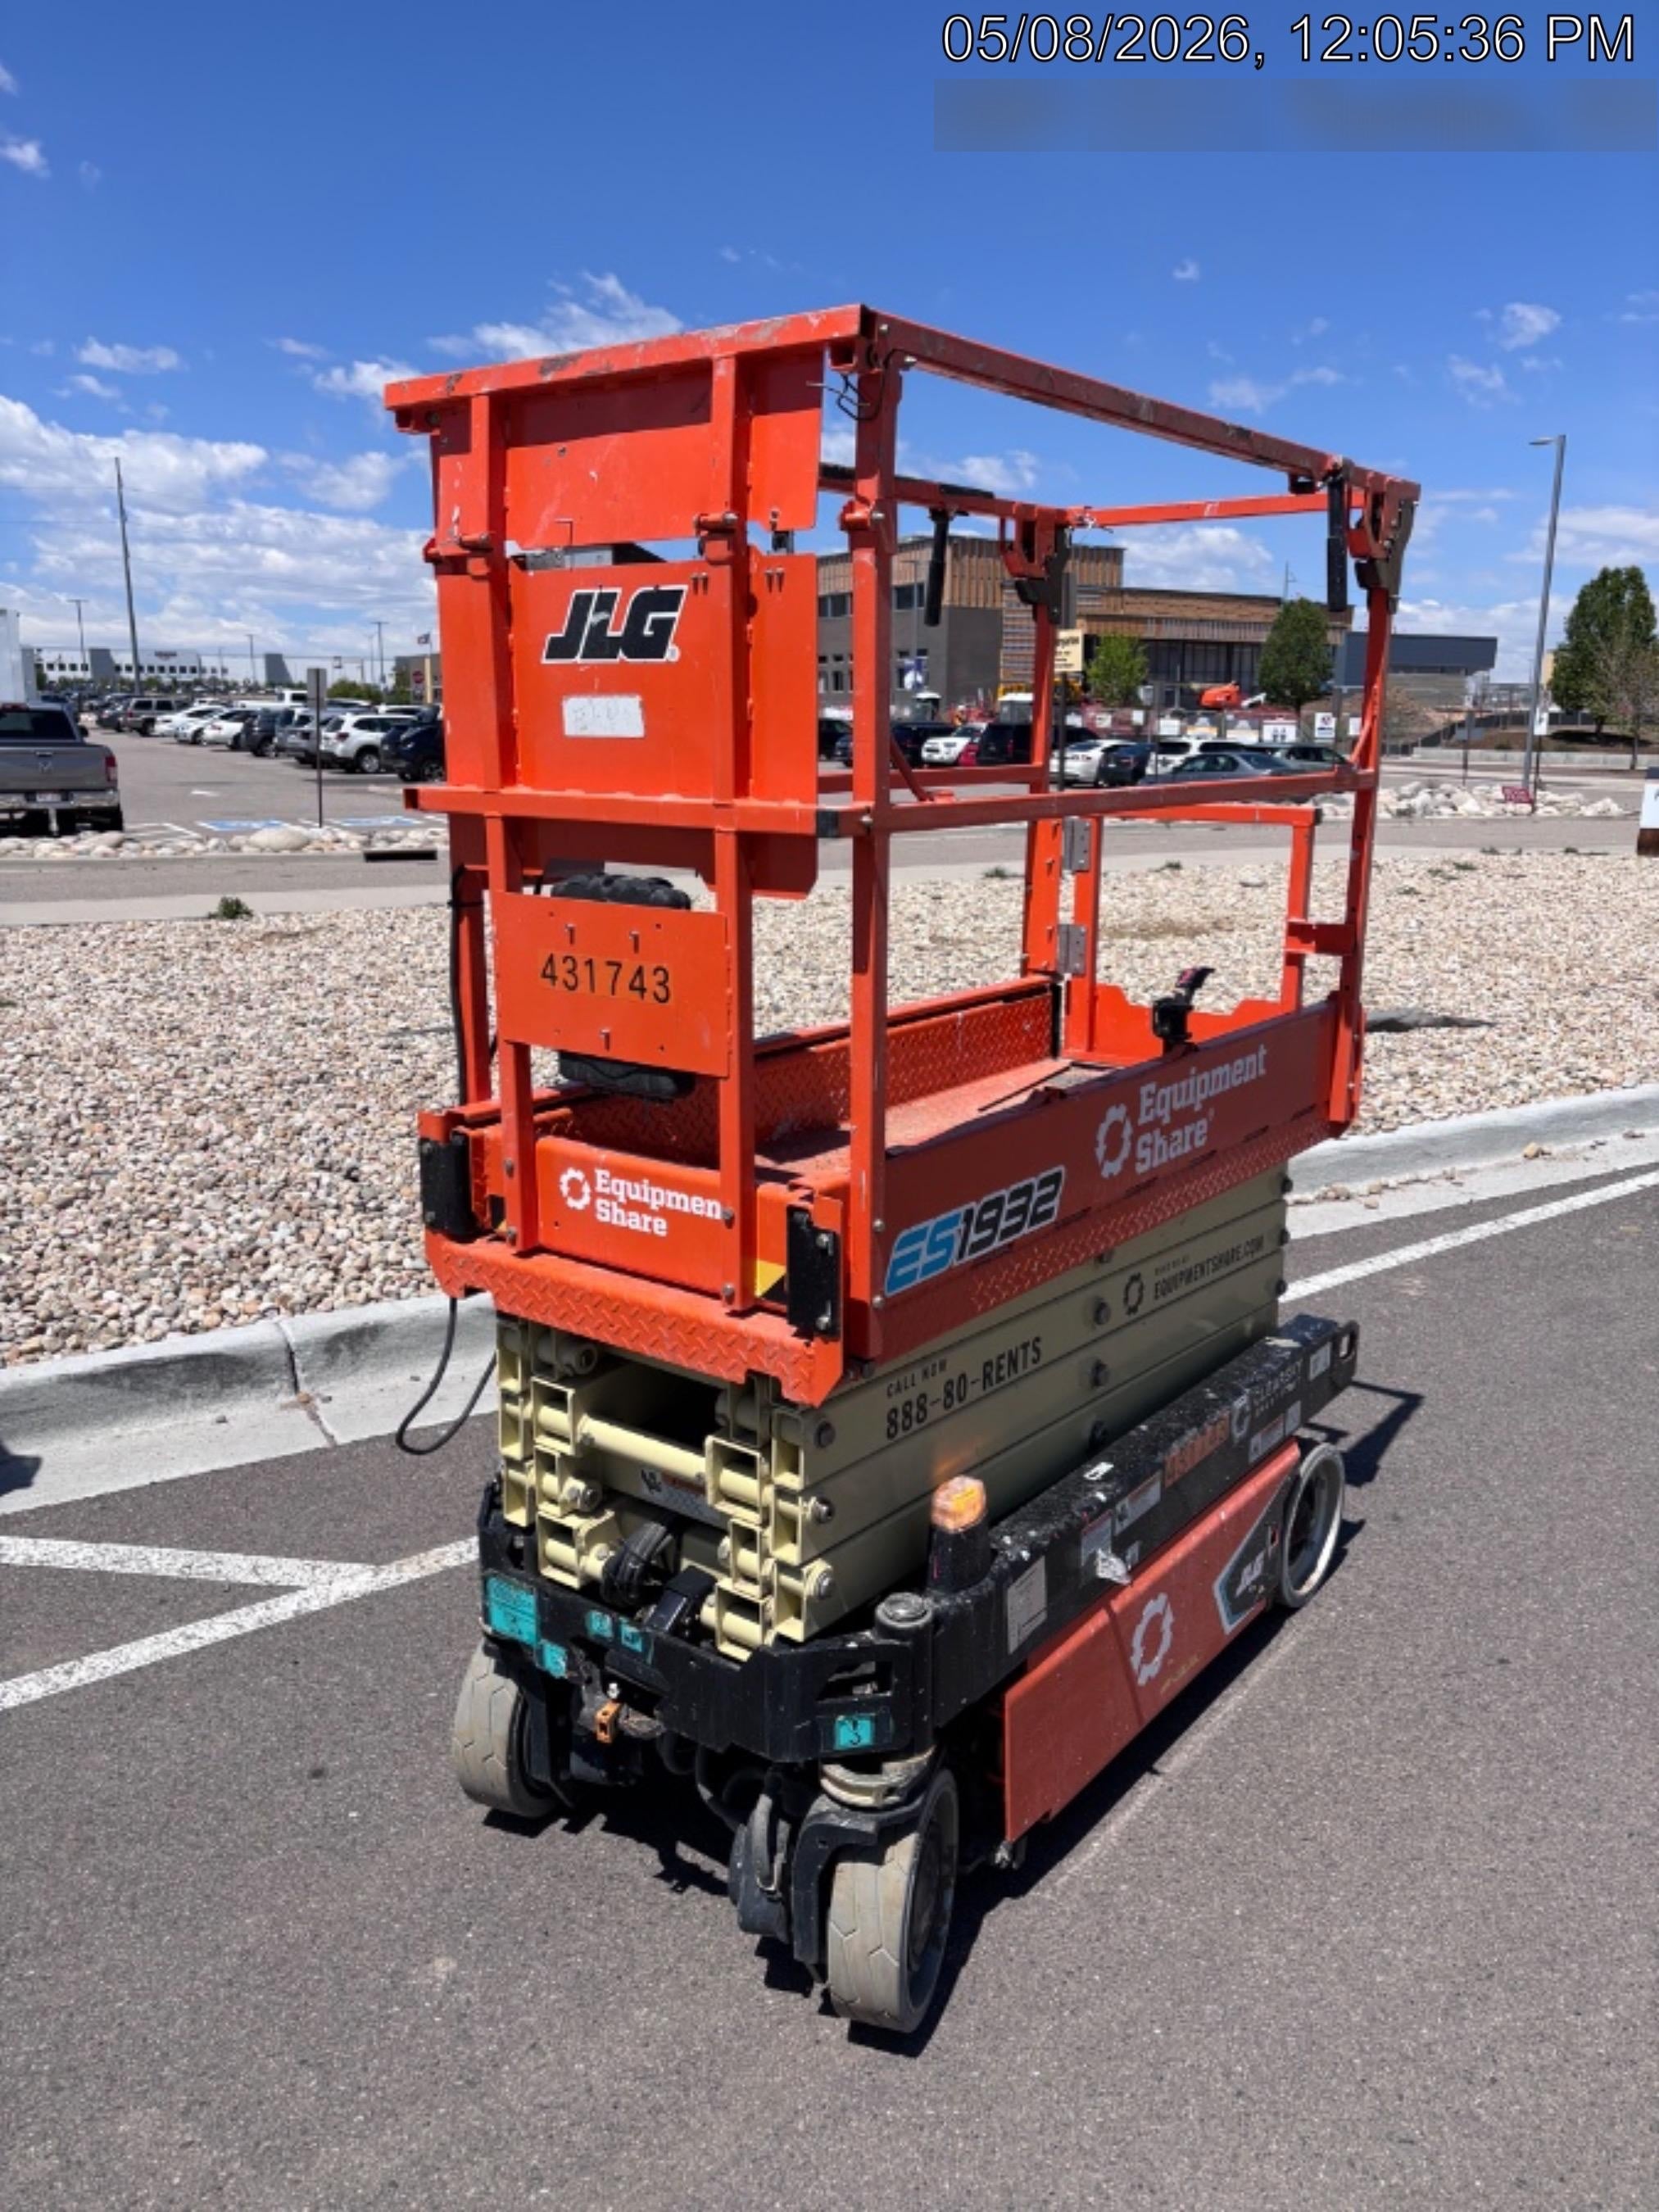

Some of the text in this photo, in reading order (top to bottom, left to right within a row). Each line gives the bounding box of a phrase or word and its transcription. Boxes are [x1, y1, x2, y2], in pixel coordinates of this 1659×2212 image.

[542, 585, 688, 664] JLG
[540, 952, 672, 1004] 431743
[1137, 1043, 1267, 1127] Equipment
[1135, 1117, 1209, 1176] Share
[594, 1167, 723, 1221] Equipmen
[596, 1199, 669, 1237] Share
[884, 1167, 1065, 1296] ES1932
[886, 1373, 916, 1398] CALL
[886, 1336, 1042, 1440] 888-80-RENTS
